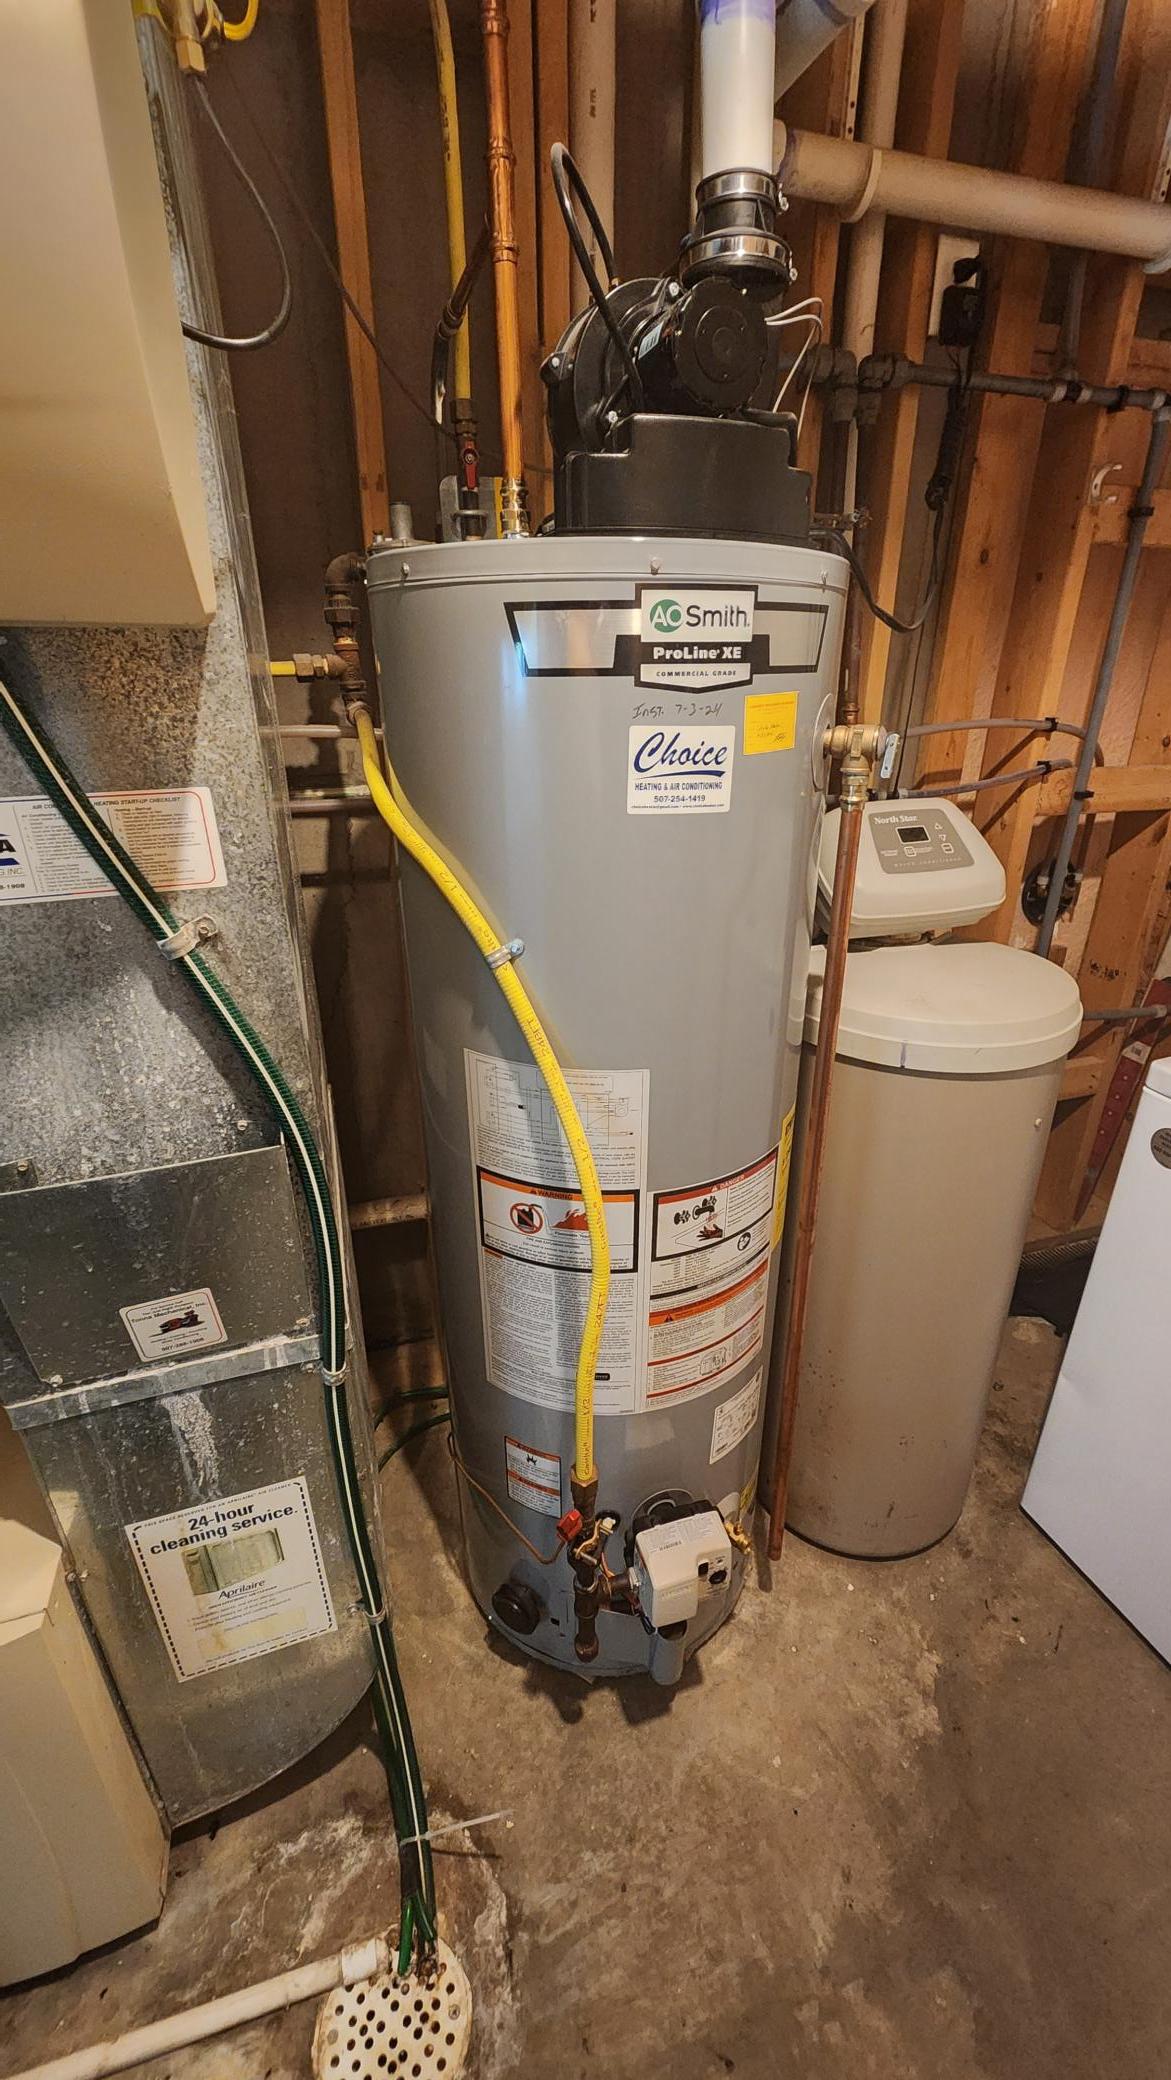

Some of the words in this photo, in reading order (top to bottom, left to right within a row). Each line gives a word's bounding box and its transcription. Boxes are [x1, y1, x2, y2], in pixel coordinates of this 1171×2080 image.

[651, 602, 682, 630] AO
[721, 646, 742, 660] XE
[674, 703, 723, 717] 7-3-24
[633, 732, 728, 773] Choice
[634, 783, 664, 791] HEATING
[663, 783, 669, 791] &
[669, 783, 680, 791] AIR
[681, 782, 722, 791] CONDITIONING
[653, 795, 706, 803] 507-254-1419
[874, 815, 899, 824] North
[538, 1190, 573, 1200] WARNING
[187, 1503, 255, 1531] 24-hour
[149, 1526, 228, 1556] cleaning
[231, 1504, 298, 1534] service.
[217, 1579, 267, 1600] Aprilaire
